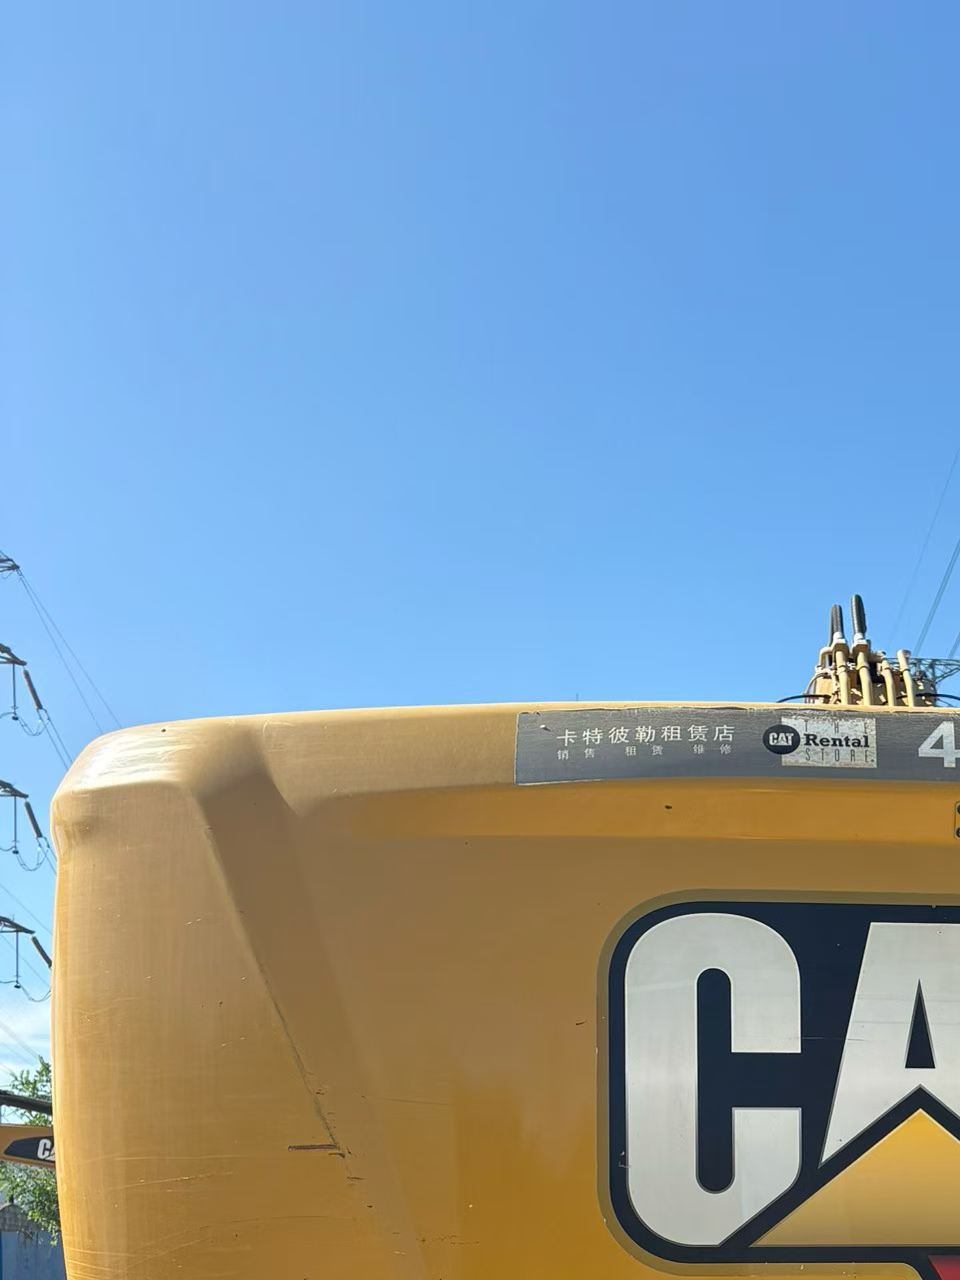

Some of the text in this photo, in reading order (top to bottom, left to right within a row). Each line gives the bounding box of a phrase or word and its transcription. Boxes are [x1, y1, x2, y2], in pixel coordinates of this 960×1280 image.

[804, 720, 869, 734] THE
[556, 725, 736, 747] 卡特彼勒租赁店
[768, 732, 870, 748] CAT Rental
[625, 745, 664, 756] 租赁
